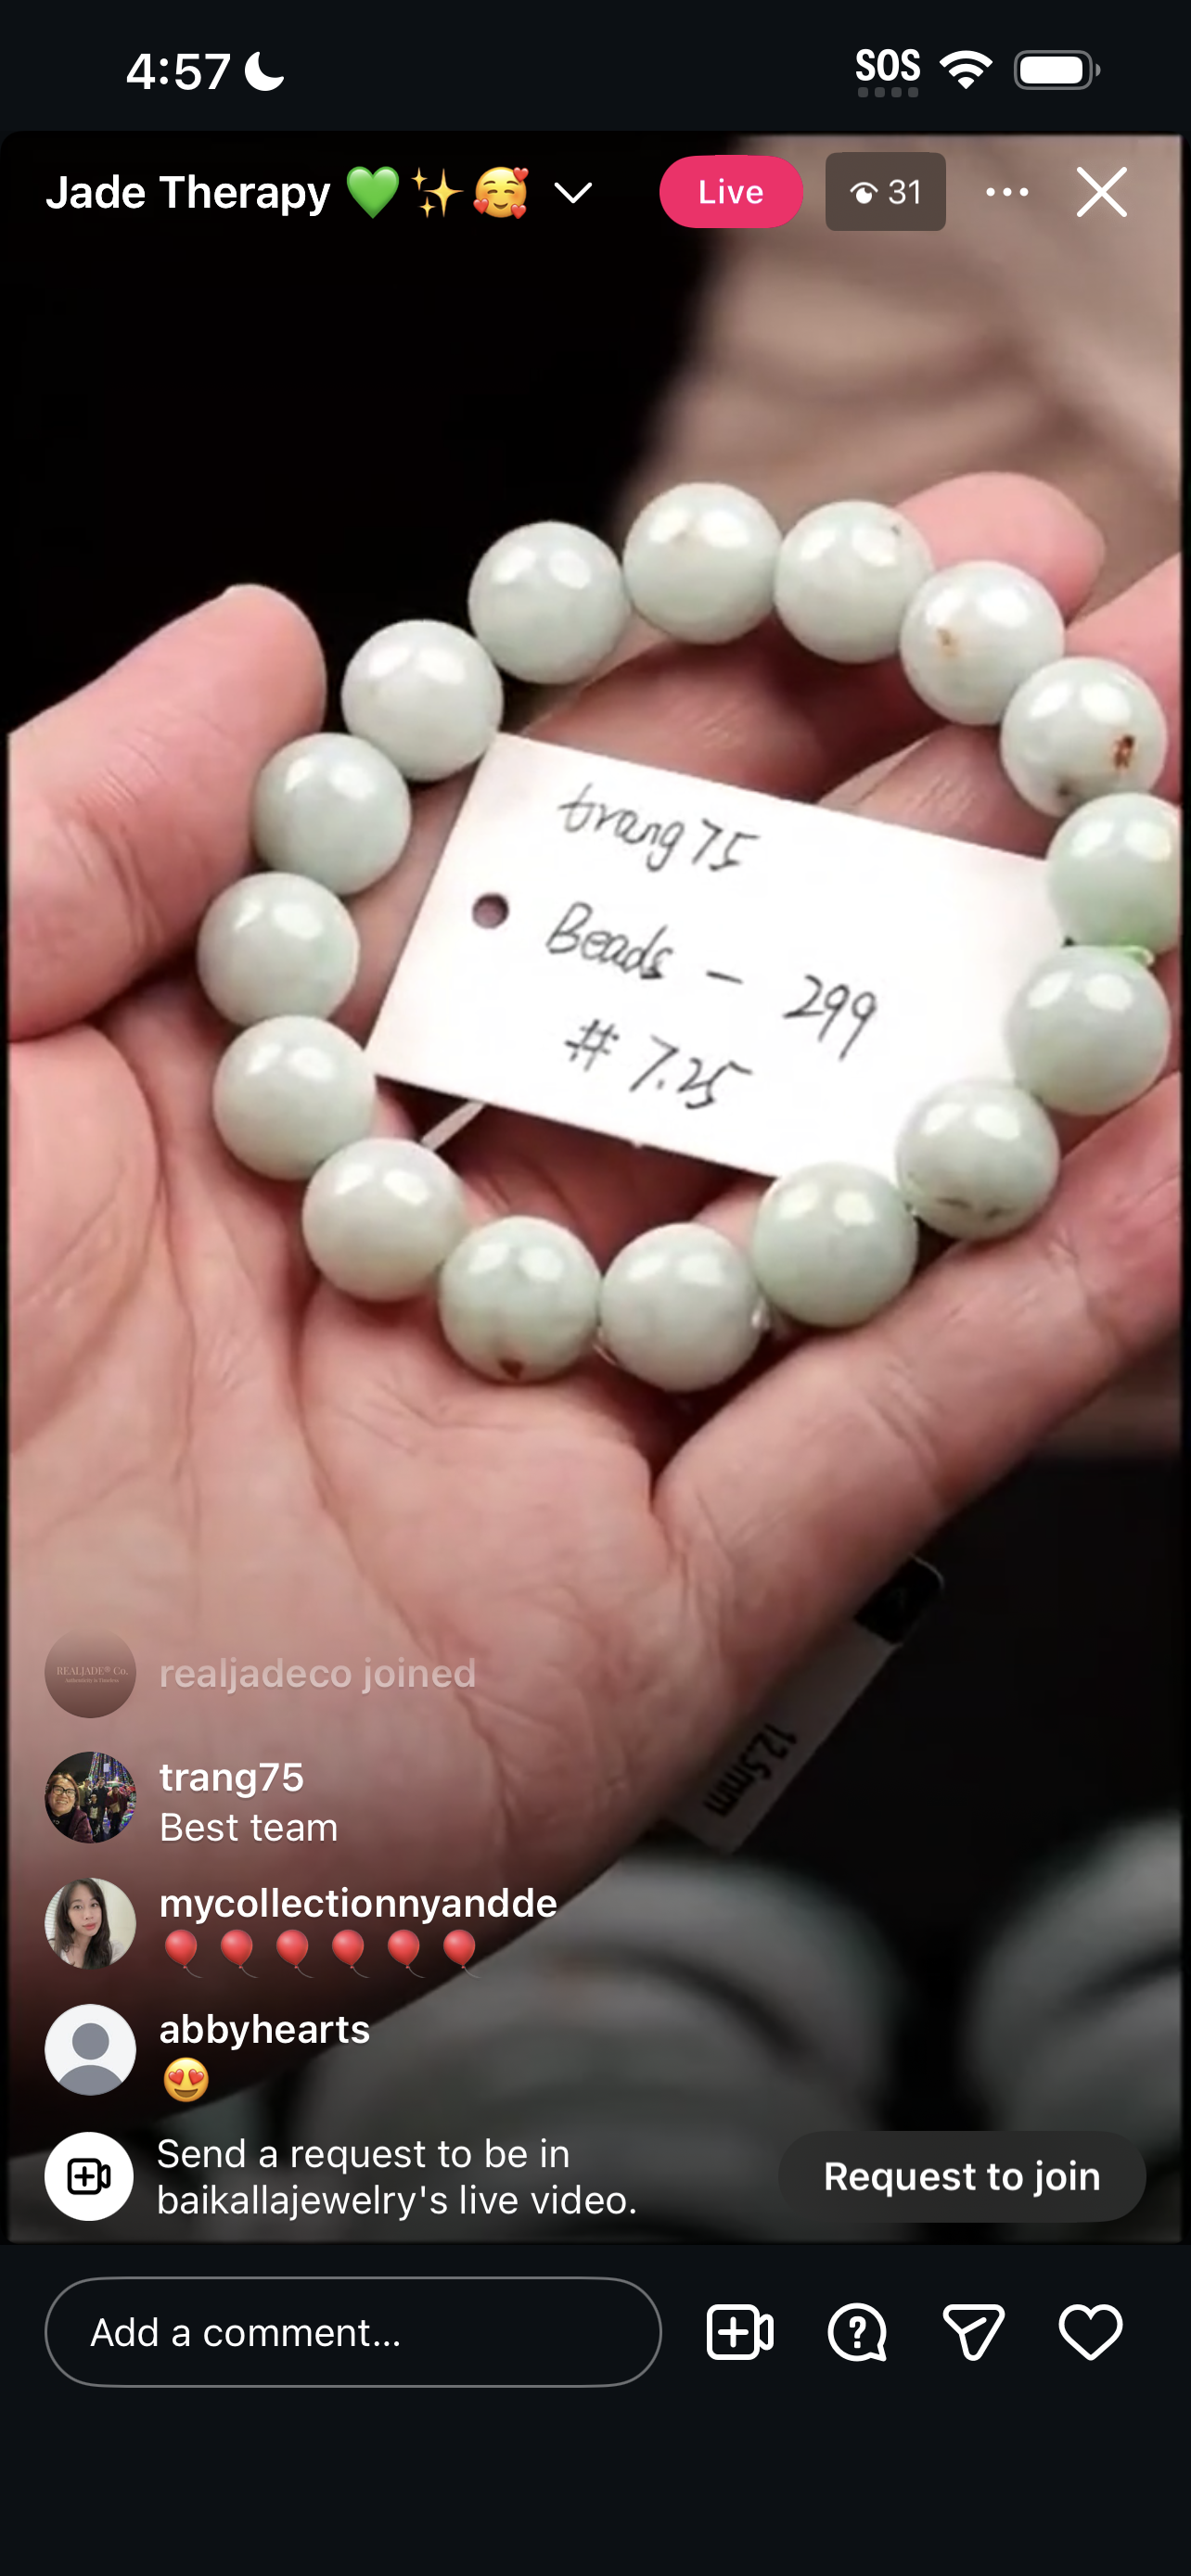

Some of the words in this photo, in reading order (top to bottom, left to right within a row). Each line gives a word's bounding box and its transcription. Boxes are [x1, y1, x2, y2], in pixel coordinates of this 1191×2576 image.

[546, 901, 673, 979] Beads
[783, 975, 877, 1061] 299
[629, 1034, 753, 1109] 7.25
